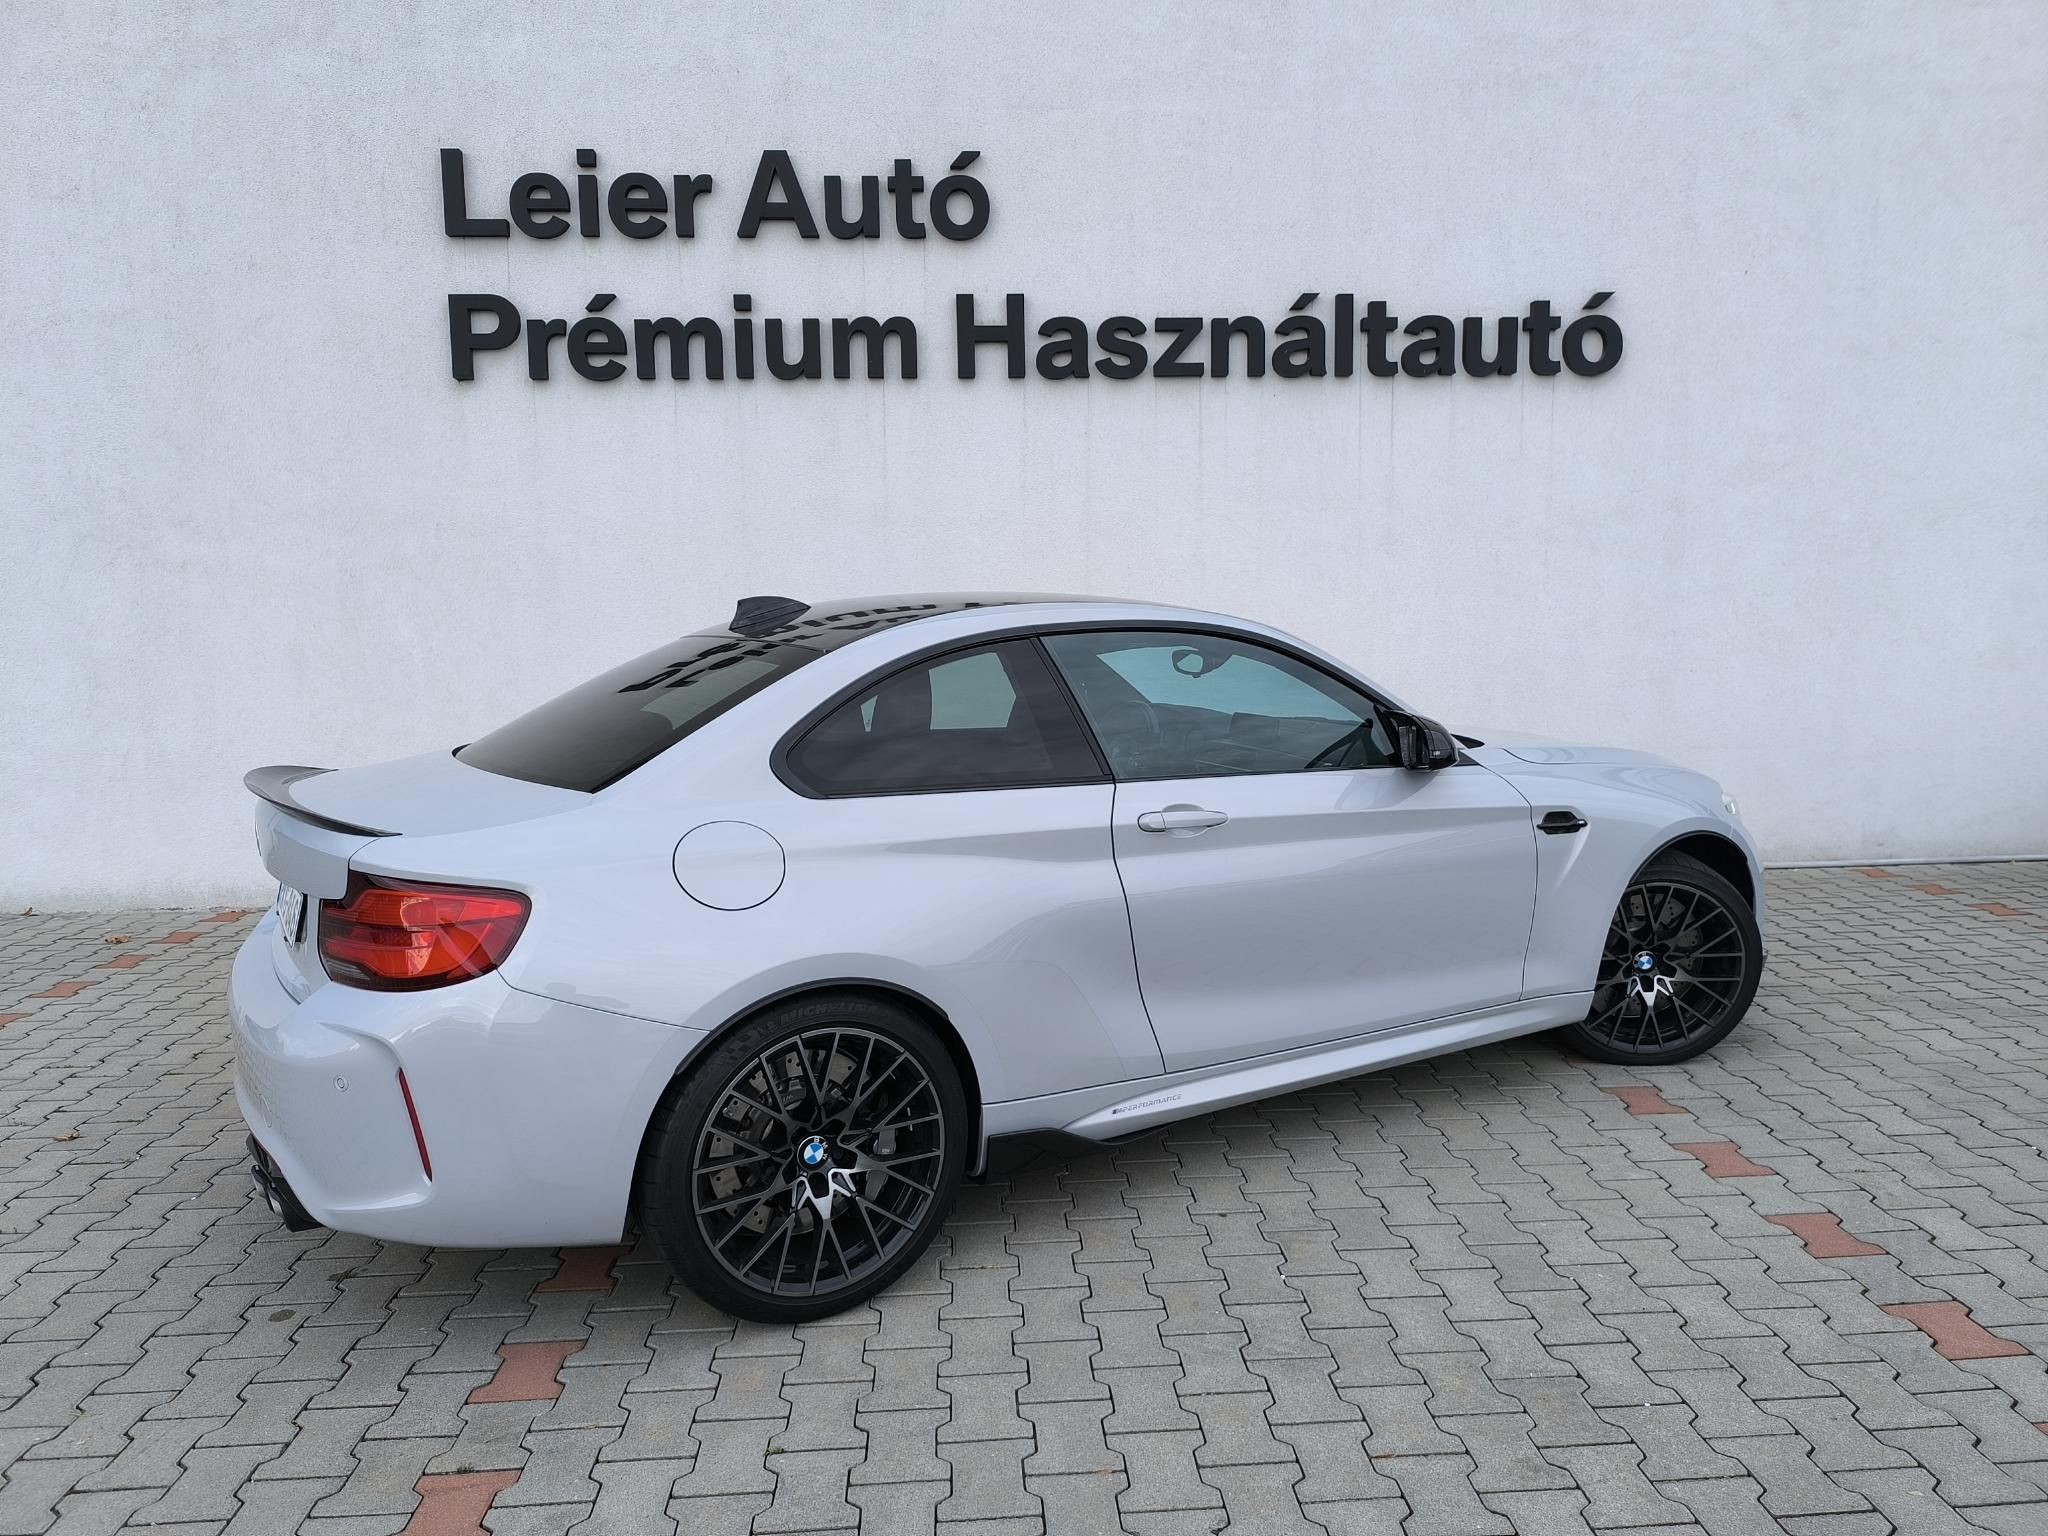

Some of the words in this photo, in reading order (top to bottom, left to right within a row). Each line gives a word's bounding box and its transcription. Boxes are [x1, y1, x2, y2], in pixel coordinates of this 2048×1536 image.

[440, 149, 712, 240] Leier
[737, 150, 990, 242] Autó
[448, 294, 917, 383] Prémium
[956, 292, 1623, 380] Használtautó
